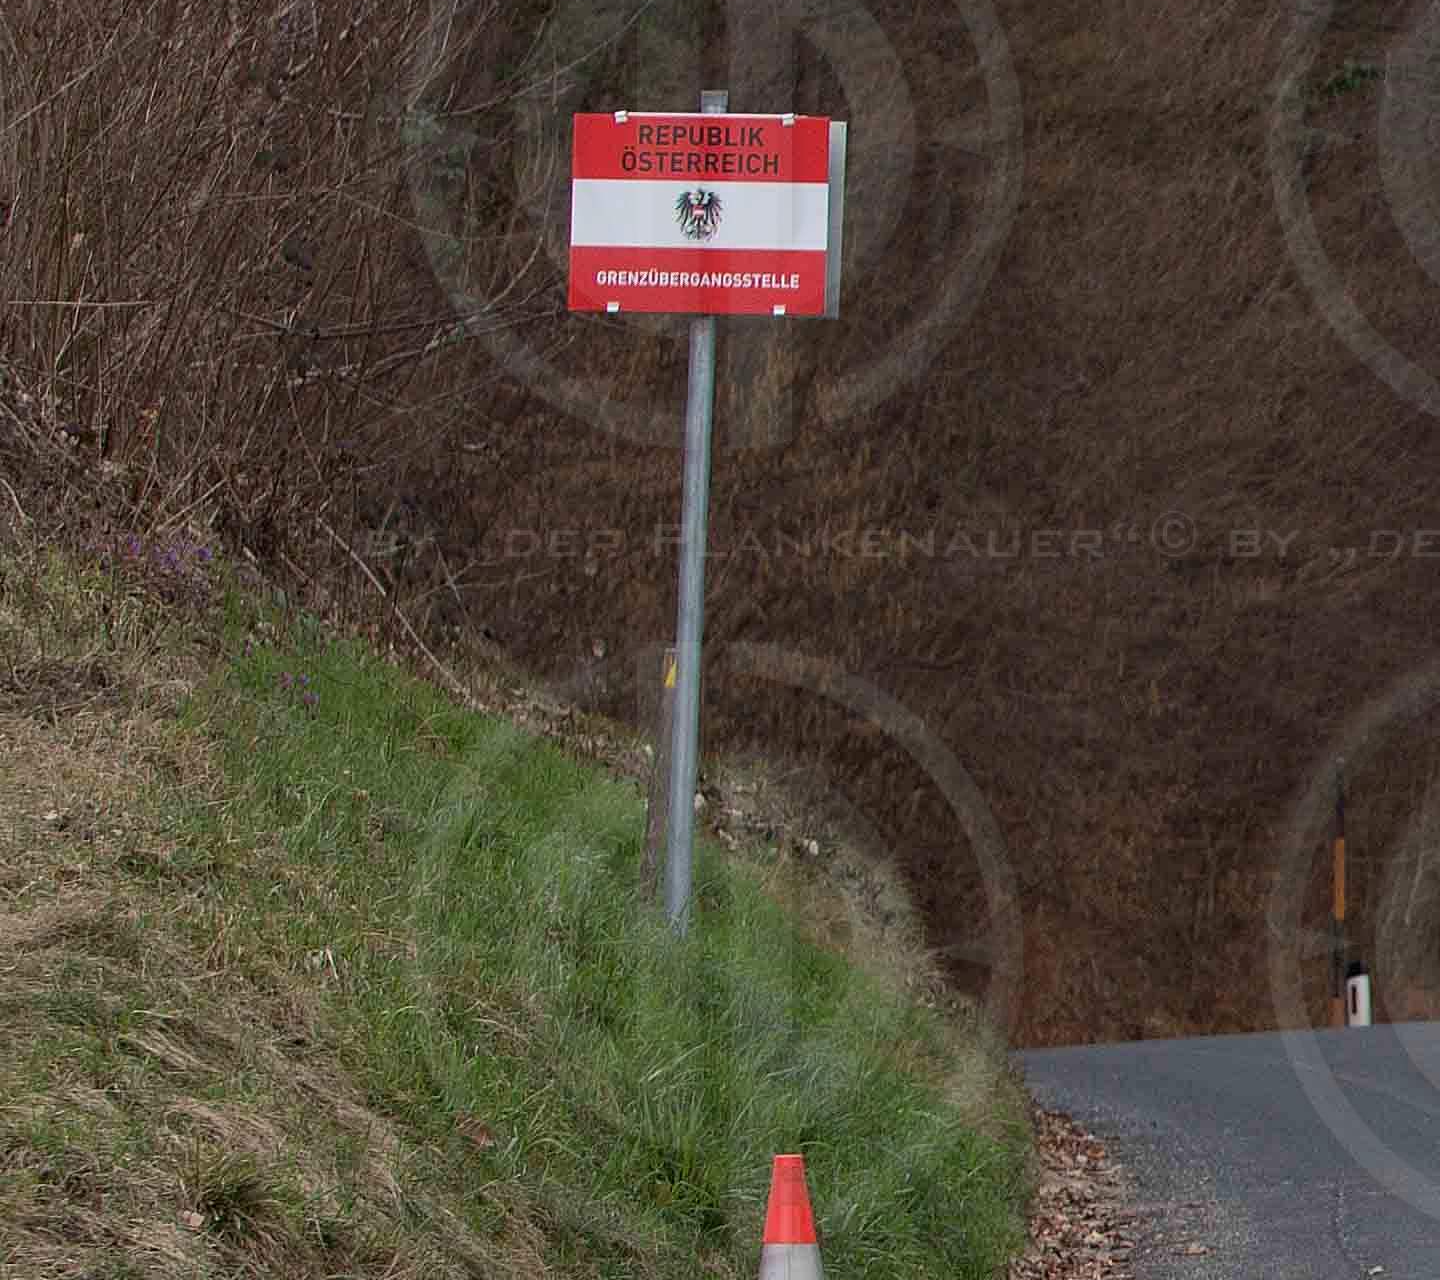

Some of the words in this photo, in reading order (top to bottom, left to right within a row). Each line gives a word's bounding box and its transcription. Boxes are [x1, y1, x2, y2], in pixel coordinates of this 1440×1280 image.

[638, 125, 766, 147] REPUBLIK
[621, 147, 780, 175] ÖSTERREICH
[596, 268, 801, 290] GRENZÜBERGANGSSTELLE
